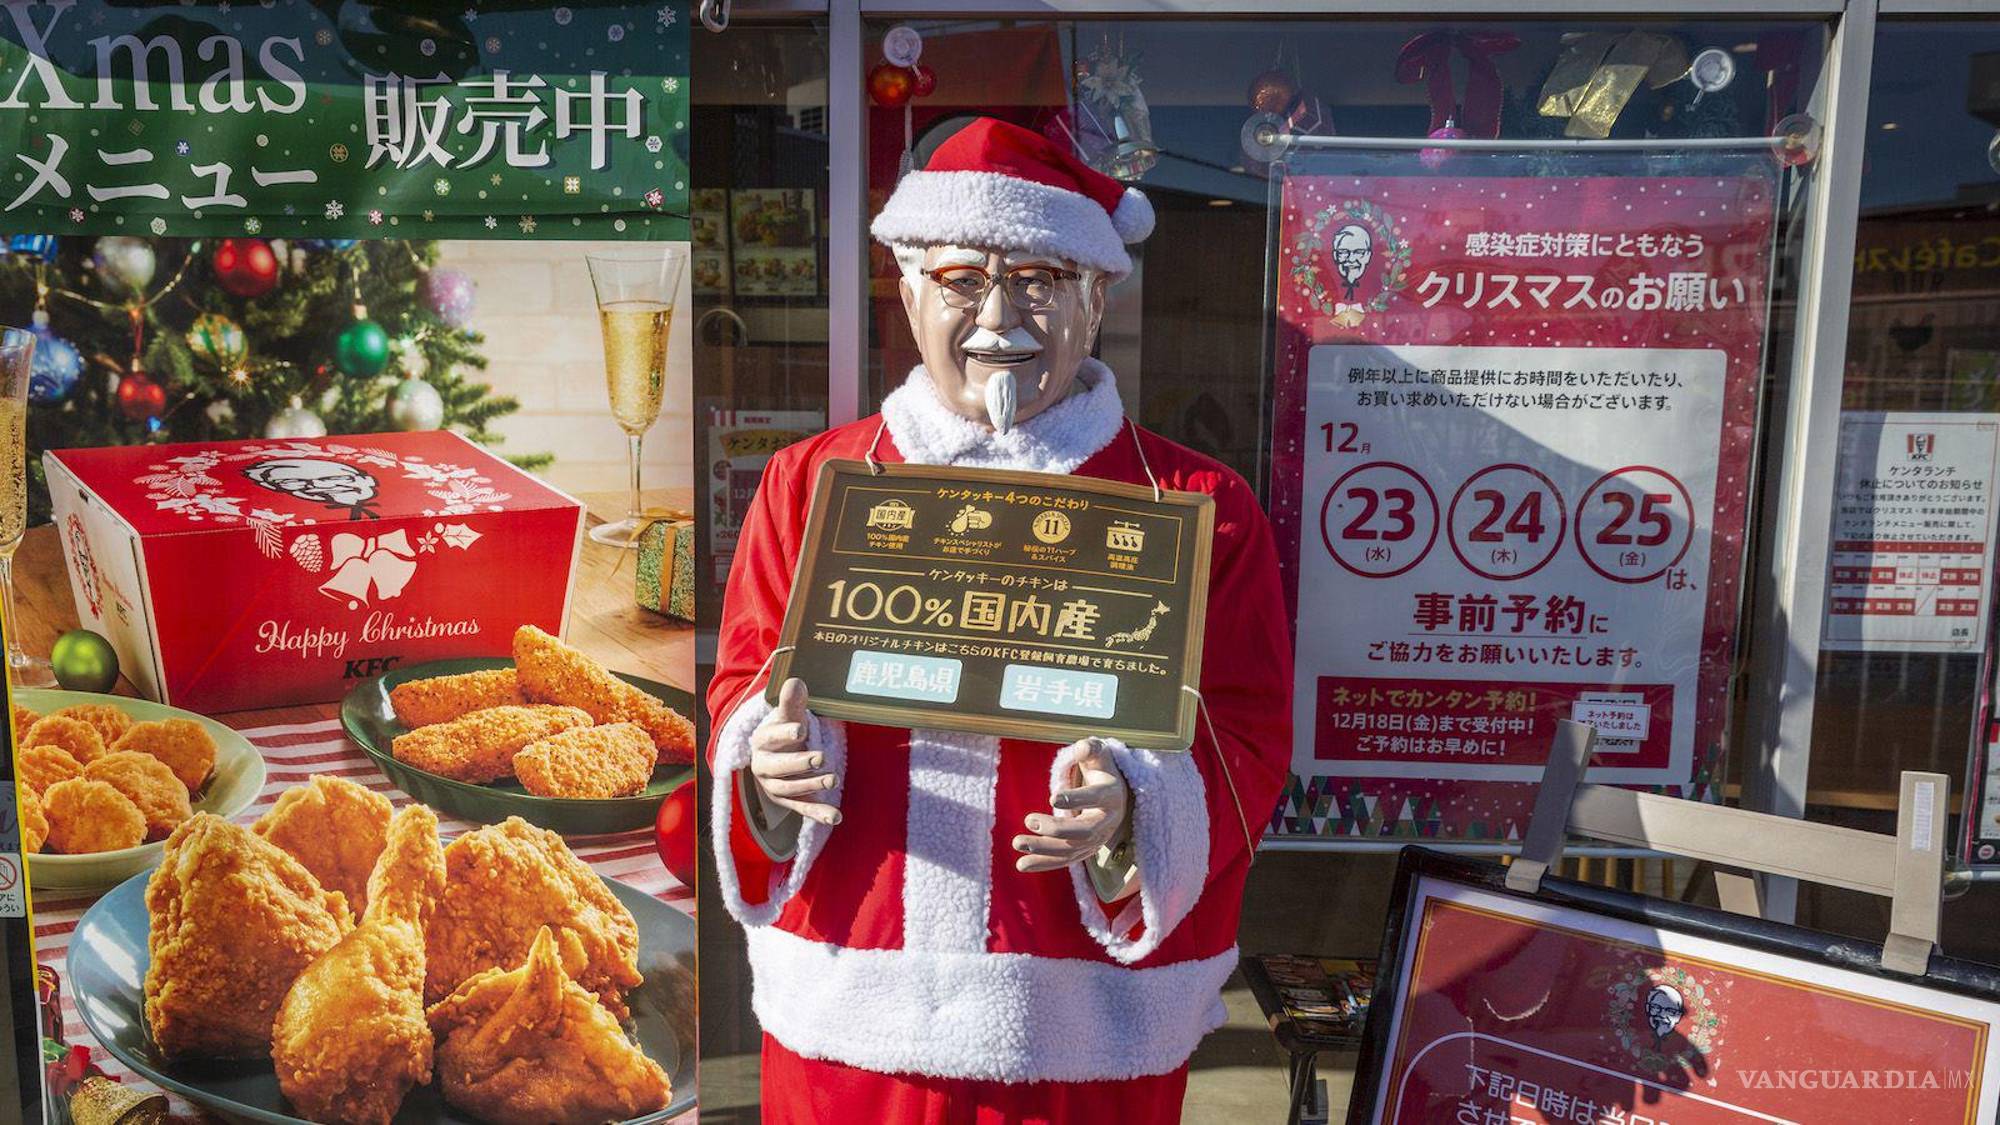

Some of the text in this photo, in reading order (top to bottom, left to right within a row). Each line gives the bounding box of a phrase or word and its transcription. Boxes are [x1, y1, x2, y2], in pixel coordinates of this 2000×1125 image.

[0, 0, 307, 114] Xmas
[364, 69, 646, 171] 販売中
[4, 134, 318, 212] メニュー
[1464, 232, 1705, 258] 感染症対策にともなう
[1415, 270, 1746, 313] クリスマスのお願い
[1347, 367, 1687, 389] 例年以上に商品提供にお時間をいただいたり、
[1355, 389, 1674, 411] お買い求めいただけない場合がございます。
[1320, 421, 1372, 455] 12月
[1859, 479, 1983, 490] 休止についてのお知らせ
[1889, 466, 1956, 476] ケンタランチ
[937, 488, 1089, 511] ケンタッキー4つのこだわり
[1342, 487, 1416, 542] 23
[1044, 519, 1059, 535] 11
[1468, 489, 1546, 544] 24
[1595, 491, 1672, 547] 25
[1365, 547, 1391, 563] (水)
[1490, 549, 1518, 565] (木)
[1619, 552, 1646, 568] (金)
[929, 568, 1069, 591] ケンタッキーのチキンは
[1666, 568, 1698, 591] は、
[827, 579, 1101, 641] 100%国内産
[1413, 592, 1609, 634] 事前予約に
[255, 611, 481, 658] Happy Christmas
[1367, 640, 1642, 669] ご協力をお願いいたします。
[852, 659, 956, 694] 鹿児島県
[1014, 675, 1106, 709] 岩手県
